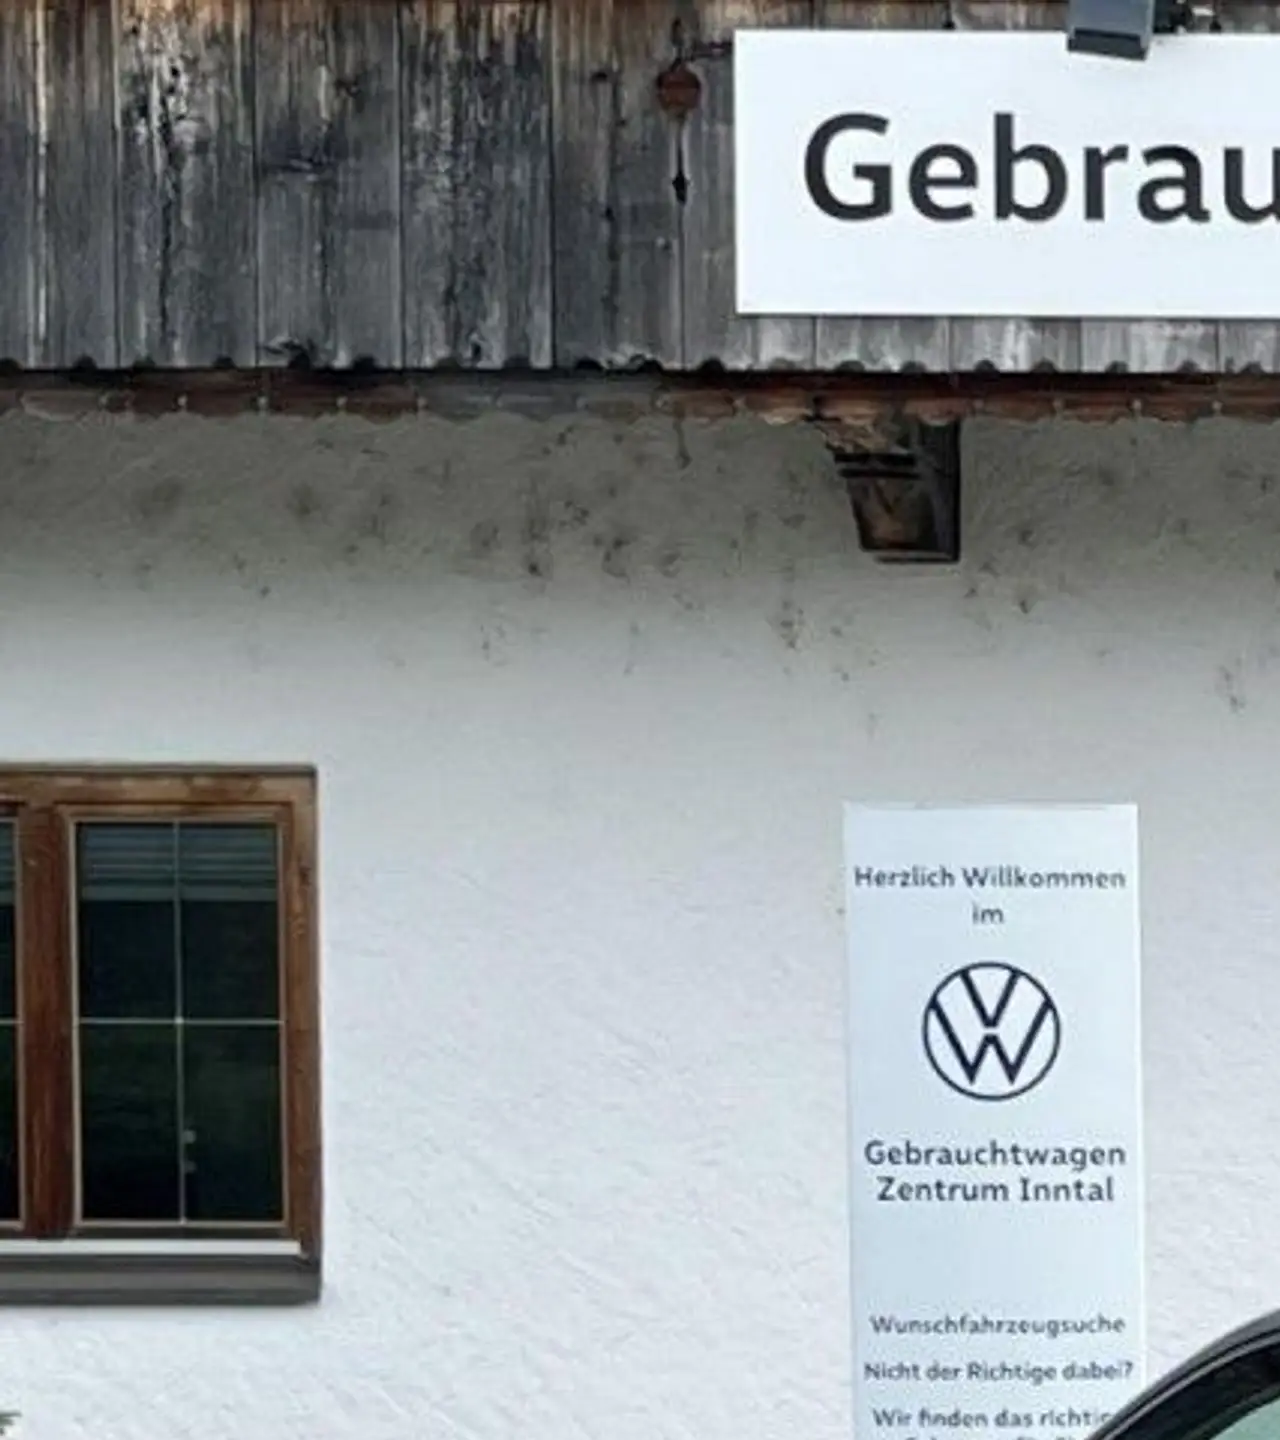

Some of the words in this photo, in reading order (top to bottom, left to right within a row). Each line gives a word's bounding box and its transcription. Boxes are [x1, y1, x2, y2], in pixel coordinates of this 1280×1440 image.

[854, 865, 956, 889] Herzlich
[960, 865, 1126, 889] Willkommen
[972, 904, 1004, 924] im
[922, 961, 1061, 1102] VW
[863, 1139, 1126, 1173] Gebrauchtwagen
[876, 1175, 1009, 1202] Zentrum
[1019, 1175, 1114, 1202] Inntal
[868, 1313, 1126, 1339] Wunschfahrzeugsuche
[863, 1360, 922, 1381] Nicht
[926, 1360, 962, 1382] der
[966, 1361, 1058, 1386] Richtige
[1061, 1359, 1134, 1381] dabei?
[872, 1408, 913, 1428] Wir
[917, 1408, 989, 1429] finden
[993, 1407, 1033, 1428] das
[1039, 1407, 1118, 1429] richti
